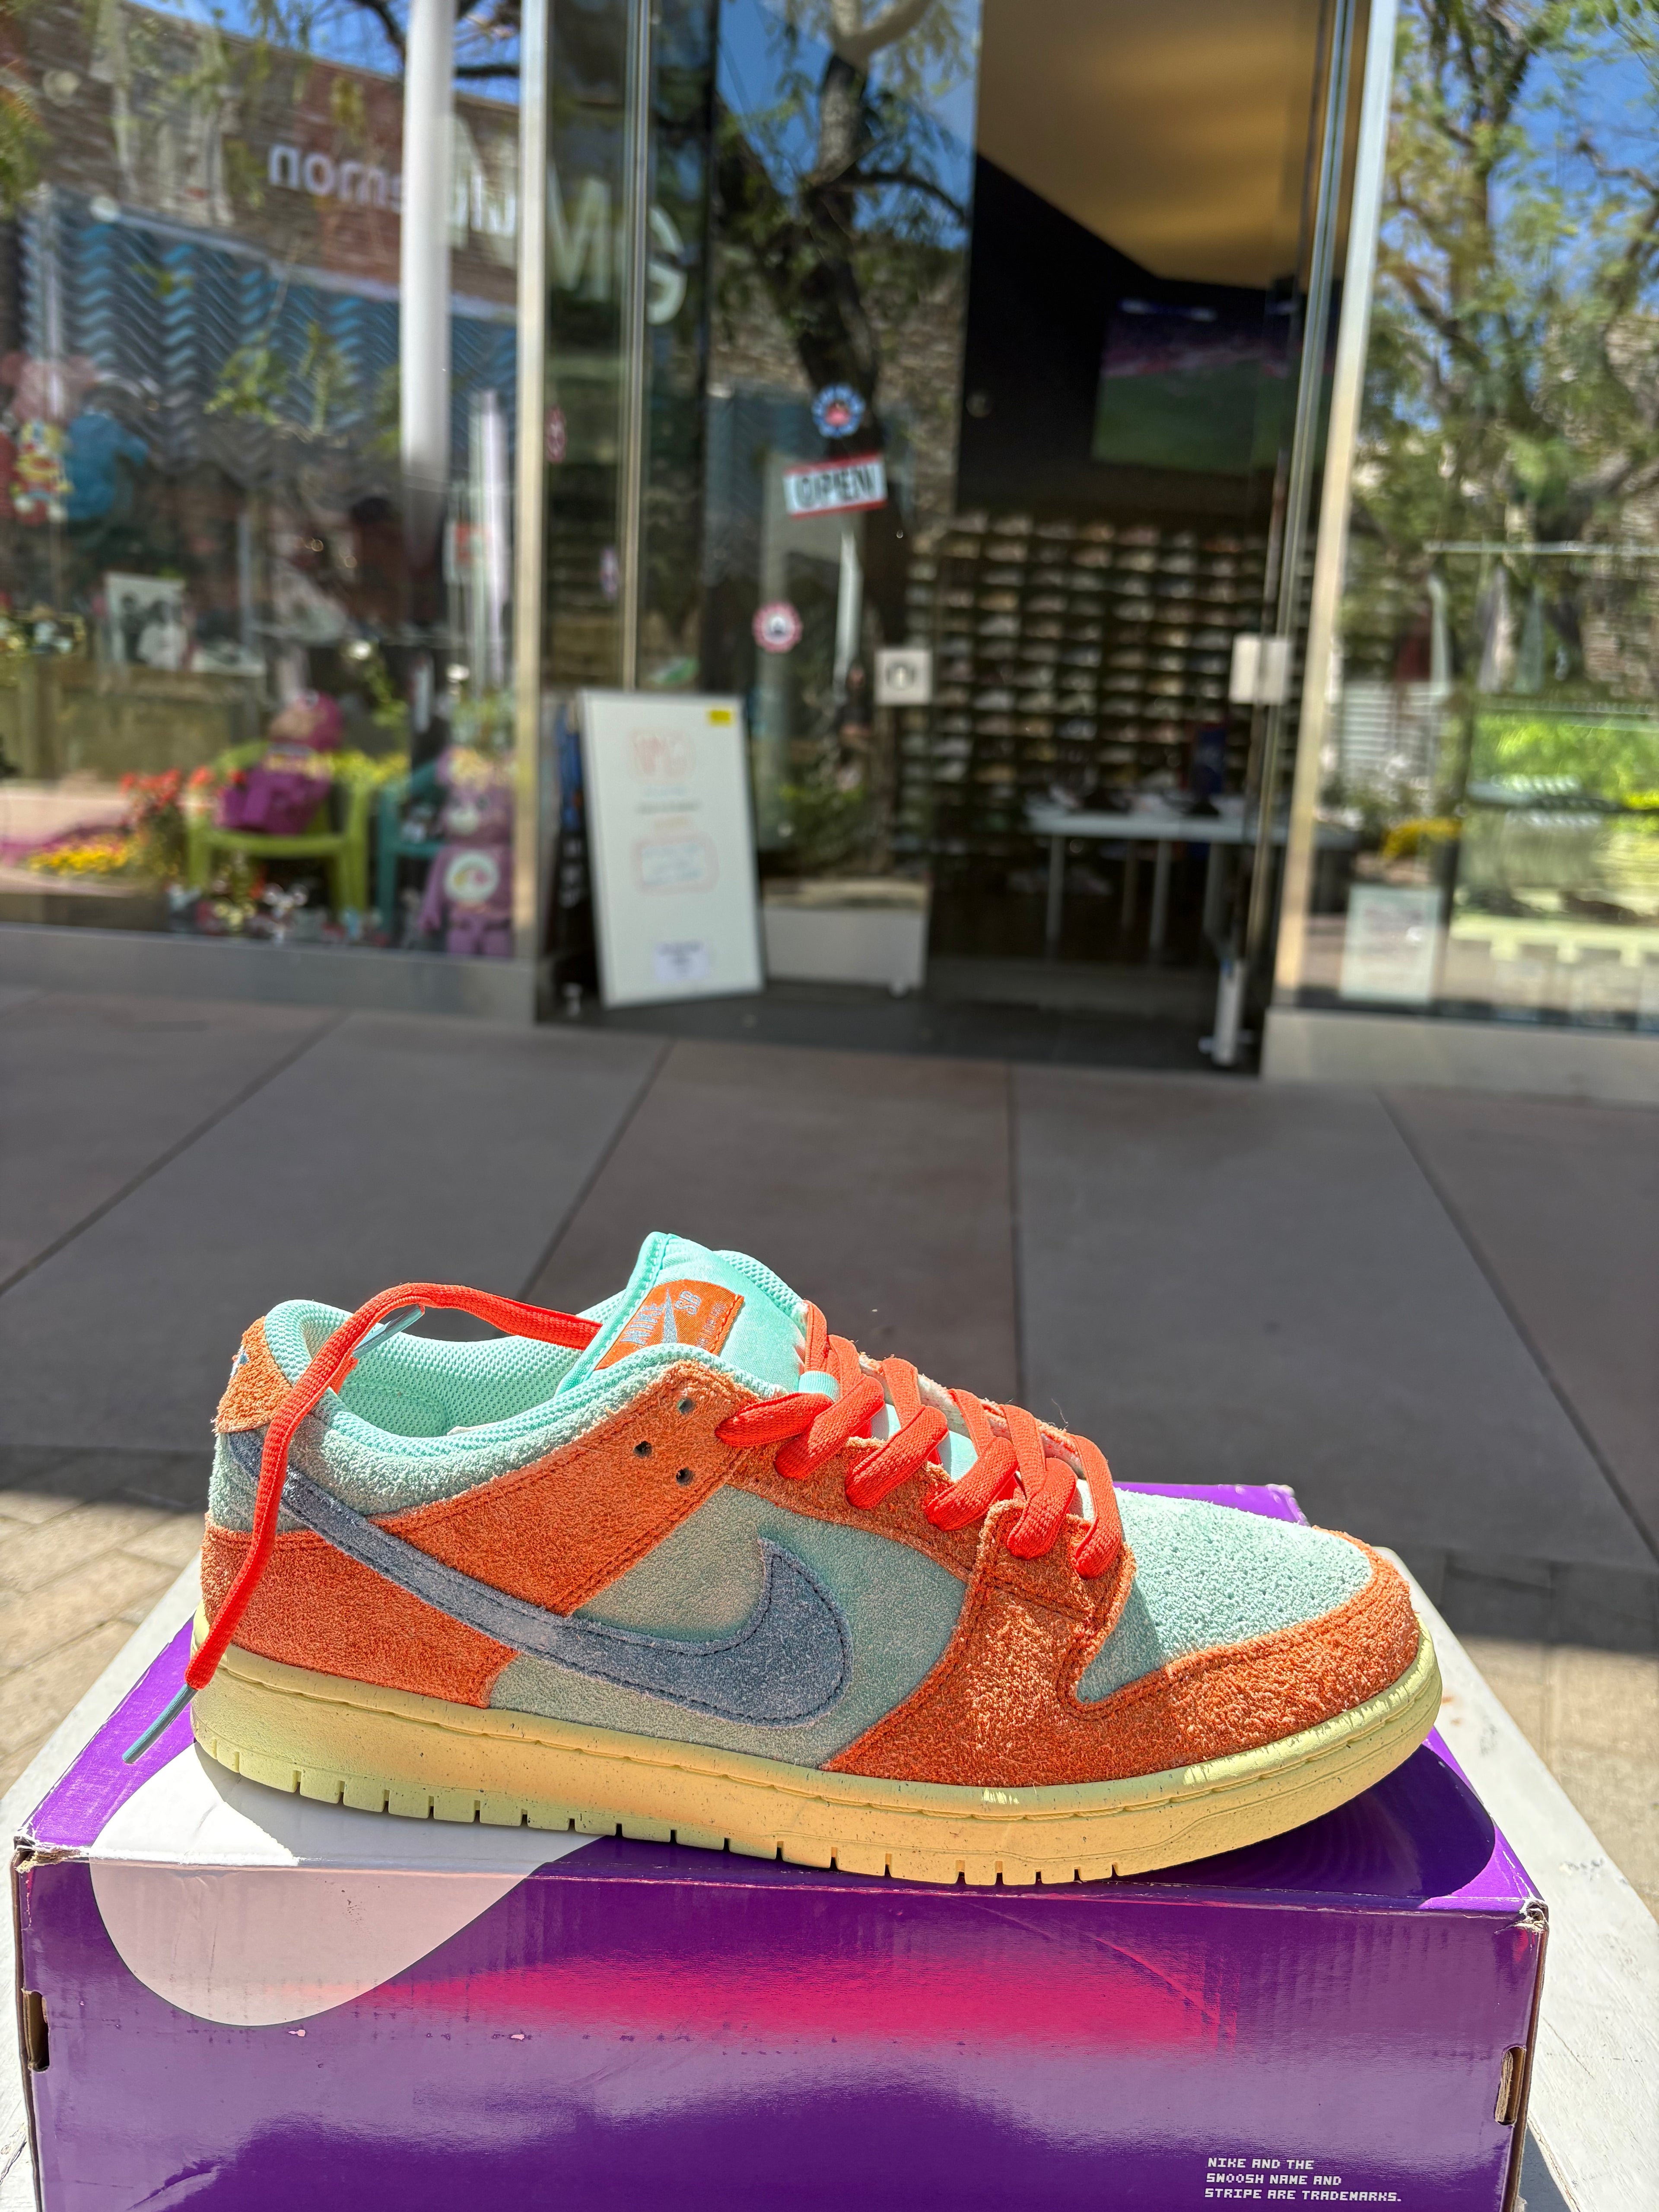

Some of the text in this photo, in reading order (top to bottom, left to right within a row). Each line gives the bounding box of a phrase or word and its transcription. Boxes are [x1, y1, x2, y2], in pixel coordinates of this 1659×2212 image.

[794, 462, 876, 509] OPEN
[674, 1290, 702, 1316] SB
[620, 1303, 666, 1346] NIKE
[1208, 2158, 1314, 2170] NIKE AND THE
[1206, 2173, 1341, 2186] SWOOSH NAME AND
[1205, 2188, 1402, 2202] STRIPE ARE TRADEMARKS.
